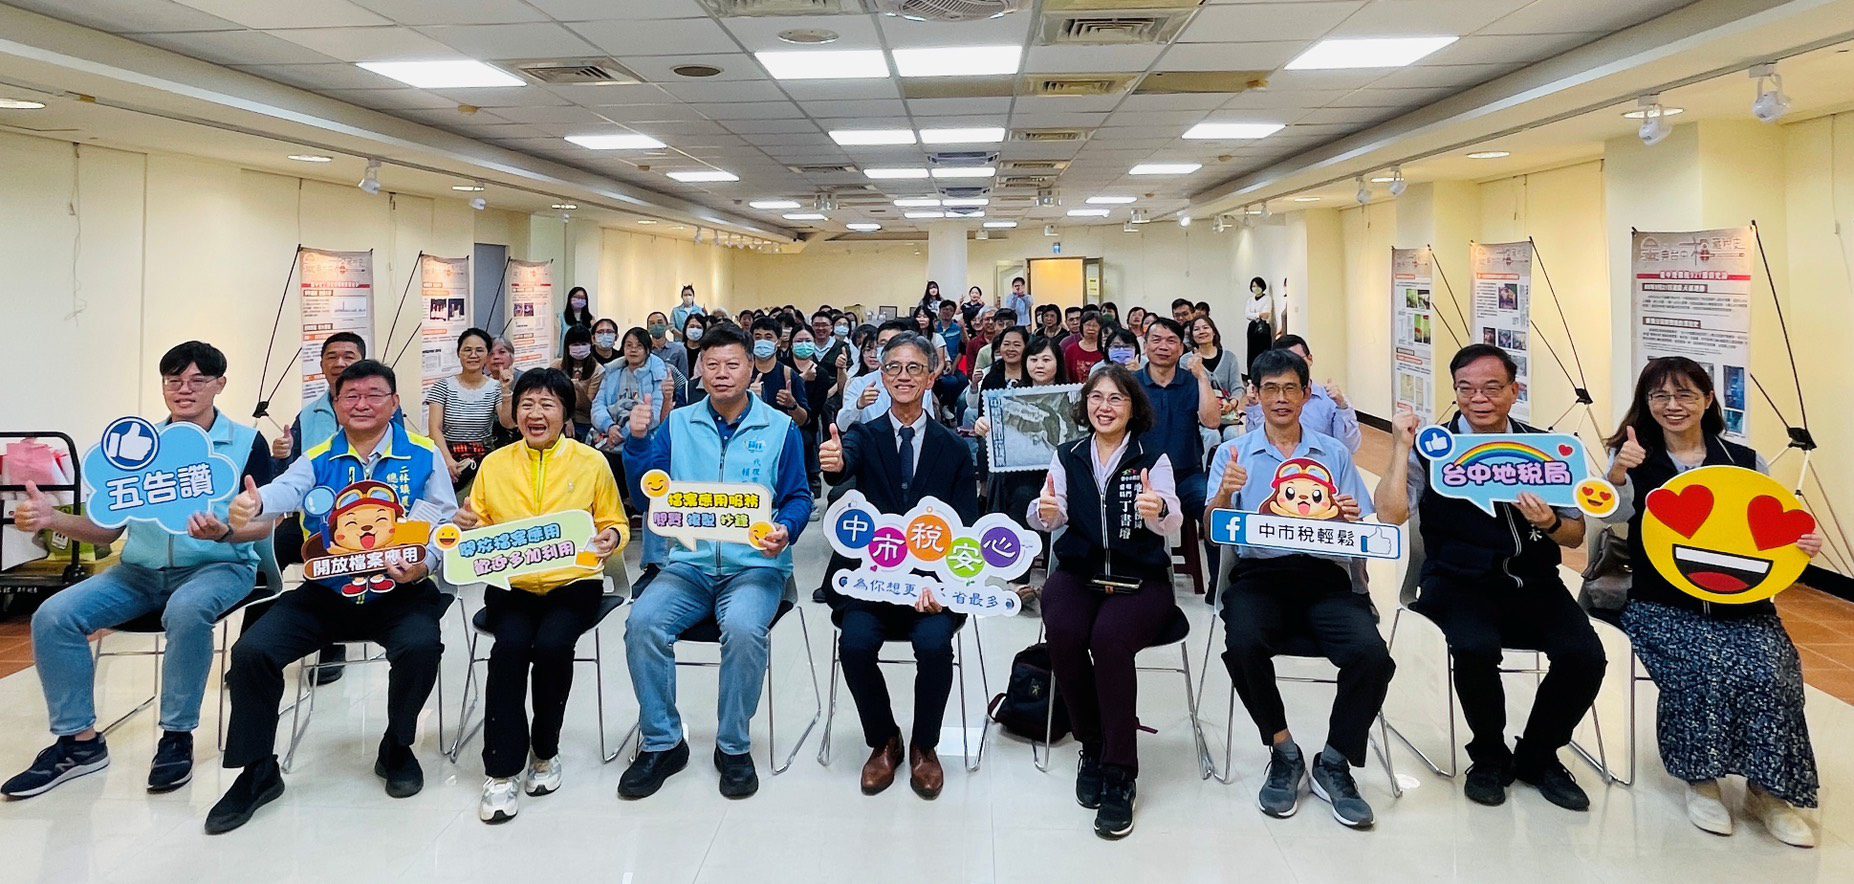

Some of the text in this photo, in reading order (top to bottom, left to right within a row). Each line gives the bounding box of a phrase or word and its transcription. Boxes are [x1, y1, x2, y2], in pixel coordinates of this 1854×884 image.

[106, 462, 214, 511] 五告讚
[1442, 461, 1572, 486] 台中地稅局
[668, 492, 760, 509] 檔案應用服務
[686, 512, 716, 527] 複製
[720, 513, 750, 528] 抄錄
[1259, 523, 1355, 547] 中市稅輕鬆
[458, 522, 561, 558] 開放檔案應用
[842, 514, 1016, 571] 中市稅安心
[313, 546, 418, 577] 開放檔案應用
[472, 540, 576, 577] 歡迎多加利用
